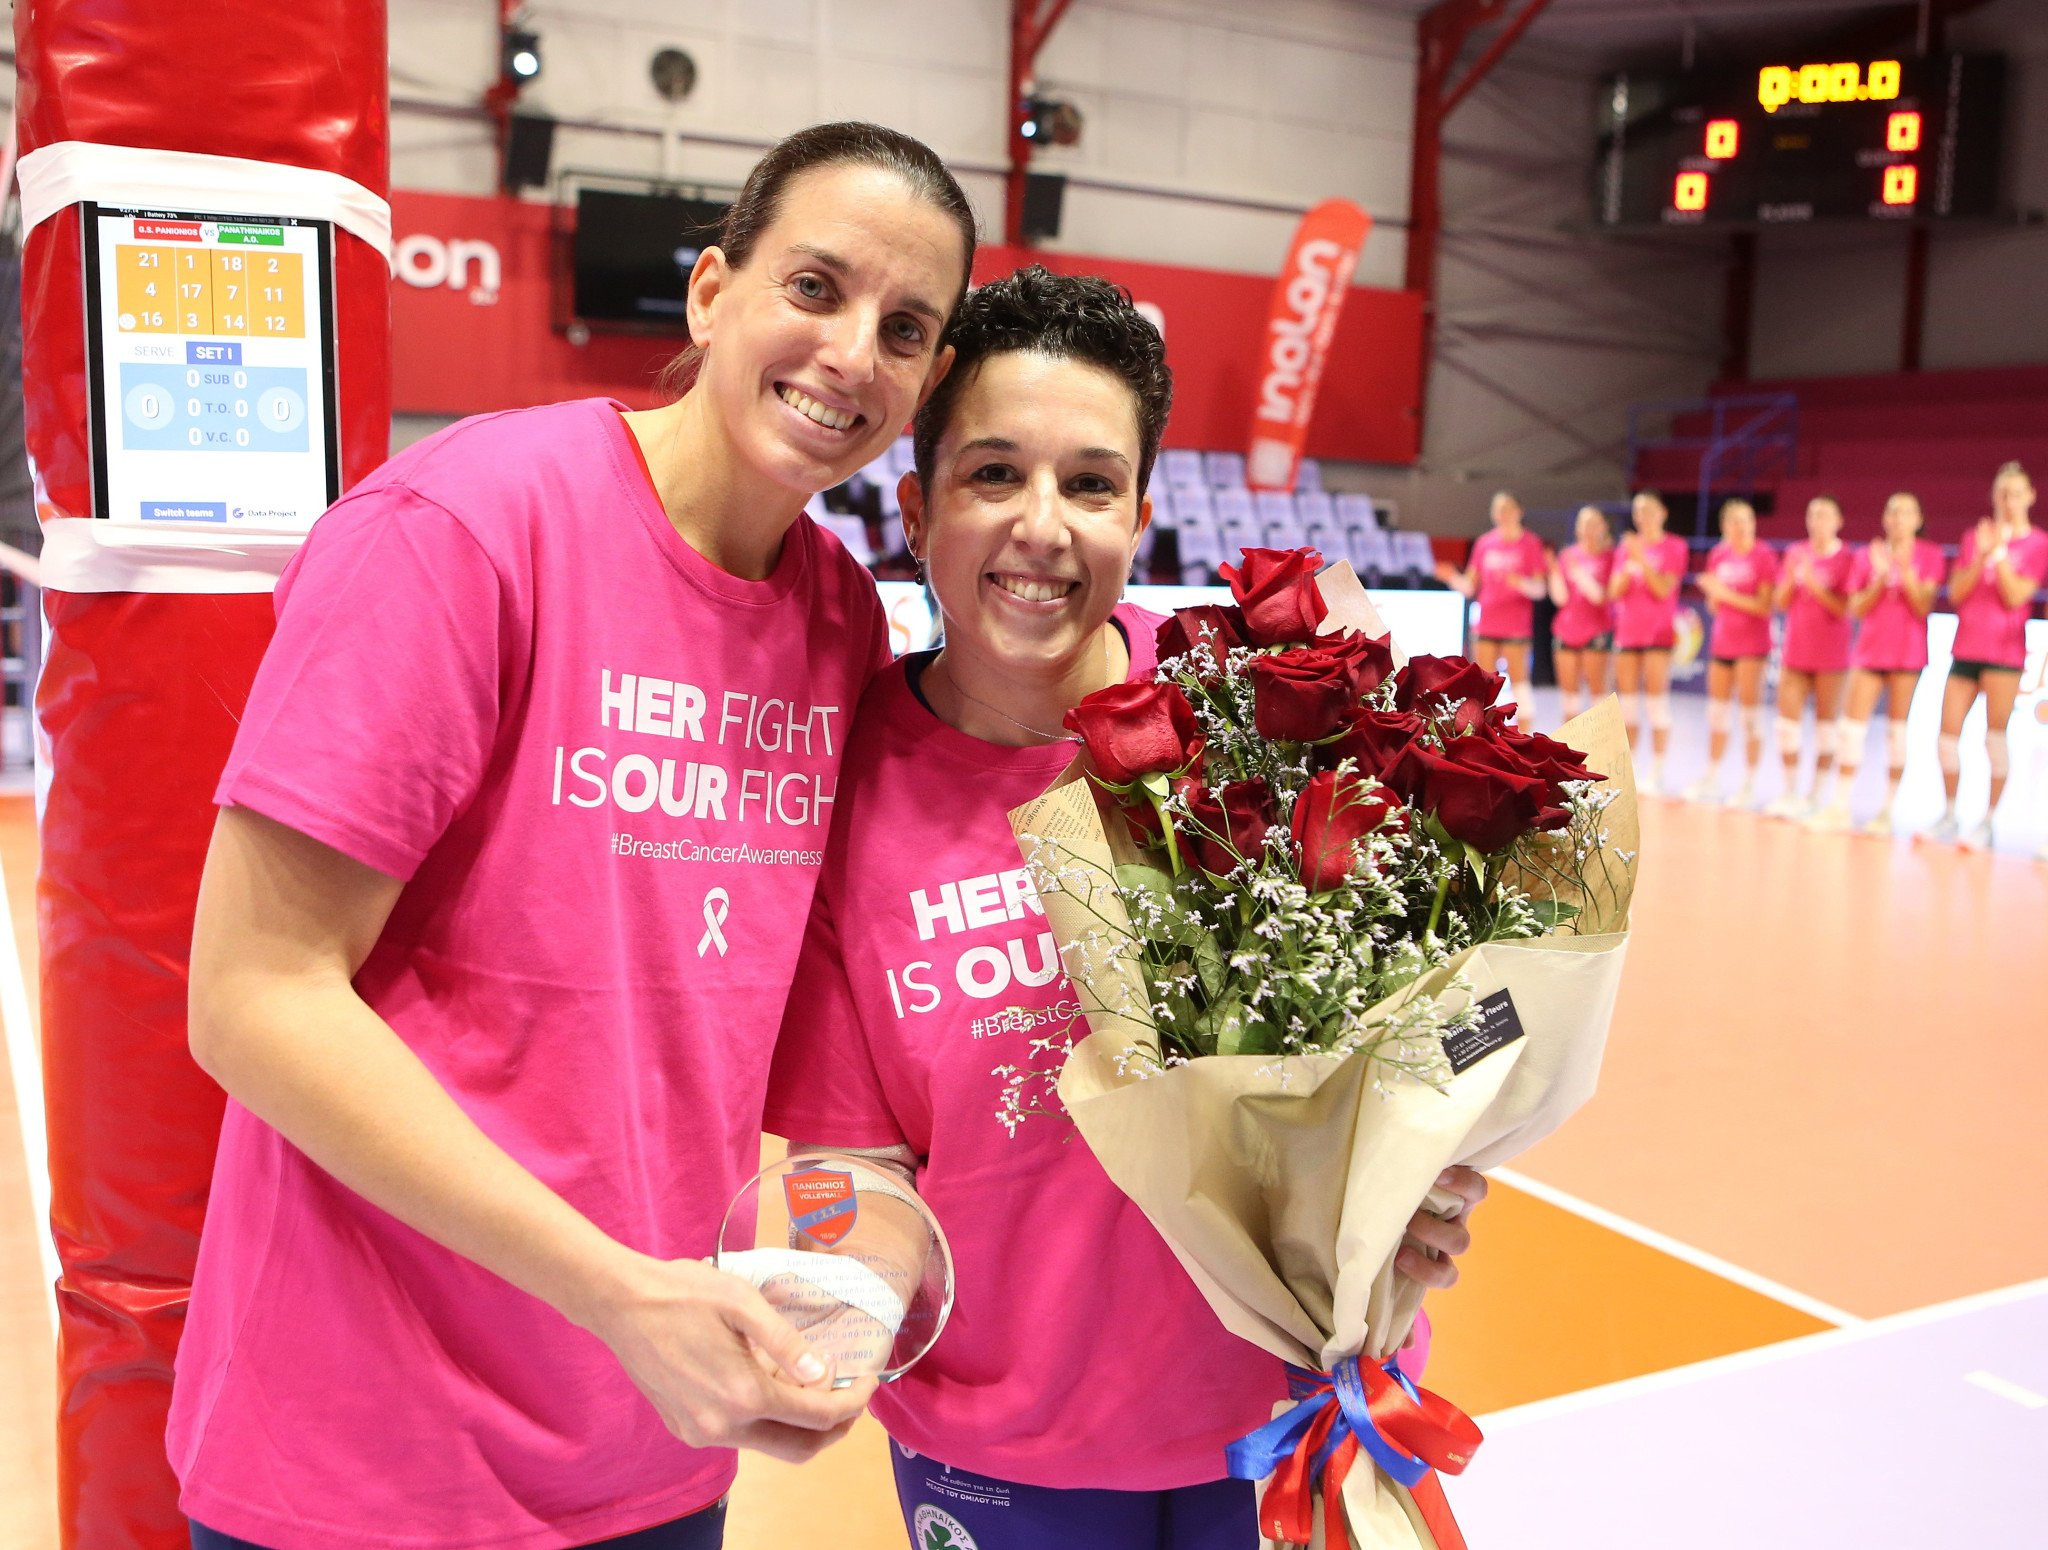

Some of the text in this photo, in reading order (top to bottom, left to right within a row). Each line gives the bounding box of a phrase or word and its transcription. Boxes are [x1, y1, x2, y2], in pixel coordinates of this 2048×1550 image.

[1705, 119, 1738, 159] 0
[1887, 112, 1920, 152] 0
[1675, 172, 1707, 211] 0
[1883, 165, 1917, 205] 0
[155, 227, 198, 235] PANIONIOS
[219, 226, 280, 235] PANATHINAIKOS
[138, 253, 159, 268] 21
[185, 255, 194, 269] 1
[222, 257, 242, 271] 18
[268, 258, 279, 273] 2
[145, 282, 156, 297] 4
[181, 284, 203, 299] 17
[227, 285, 238, 300] 7
[264, 288, 283, 302] 11
[142, 312, 163, 327] 16
[186, 313, 198, 328] 3
[224, 315, 245, 330] 14
[265, 316, 286, 331] 12
[134, 346, 174, 357] SERVE
[196, 346, 224, 360] SET
[186, 369, 247, 389] 0 SUB 0
[141, 394, 160, 419] 0
[187, 398, 248, 418] 0 T.O. 0
[272, 397, 290, 421] 0
[188, 427, 249, 447] 0 V.C. 0
[154, 507, 214, 518] Switch teams
[268, 509, 297, 518] Project
[602, 669, 839, 756] HER FIGHT
[552, 746, 838, 826] IS OUR FIGH
[1026, 797, 1047, 828] Weniger
[610, 832, 822, 866] #BreastCancerAwareness
[909, 868, 1045, 941] HER
[886, 932, 1059, 1019] IS OU
[792, 1181, 846, 1190] ΠΑΝΙΩΝΙΟΣ
[800, 1192, 842, 1200] VOLLEYBALL
[960, 1494, 990, 1504] ΟΜΙΛΟΥ
